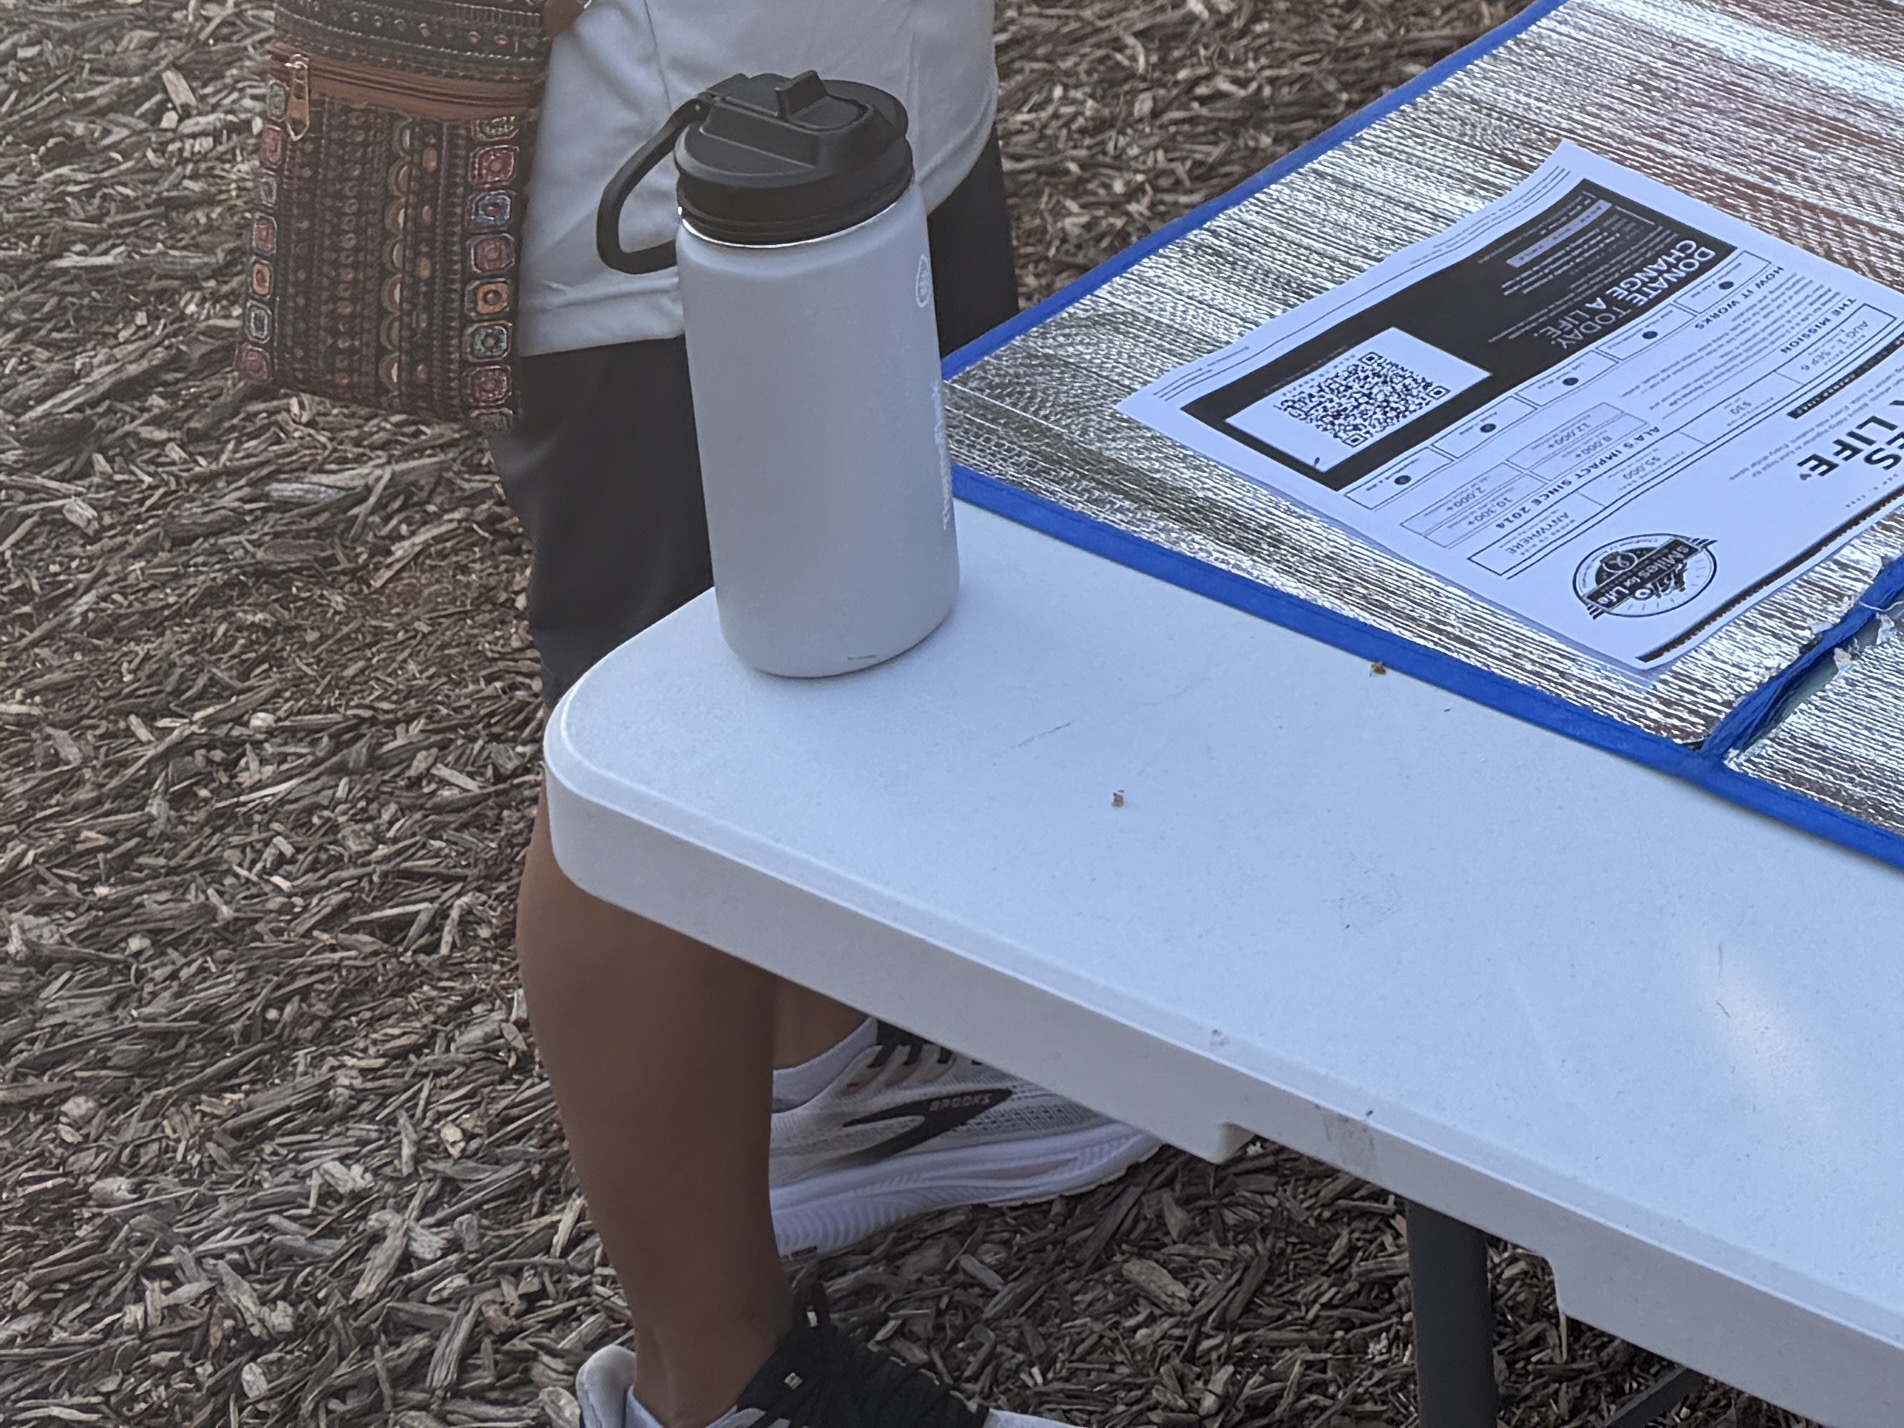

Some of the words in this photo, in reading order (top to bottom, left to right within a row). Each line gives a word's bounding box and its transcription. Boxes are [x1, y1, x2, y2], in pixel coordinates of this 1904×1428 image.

[1605, 239, 1696, 299] CHANGE
[1625, 246, 1715, 306] DONATE
[1754, 265, 1784, 288] HOW
[1584, 296, 1607, 309] A
[1740, 288, 1754, 299] IT
[1830, 297, 1857, 316] THE
[1694, 299, 1739, 329] WORKS
[1780, 316, 1831, 353] MISSION
[1796, 415, 1897, 476] LIFE
[1574, 449, 1622, 479] IMPACT
[1530, 479, 1572, 506] SINCE
[930, 1094, 992, 1112] BROOKS
